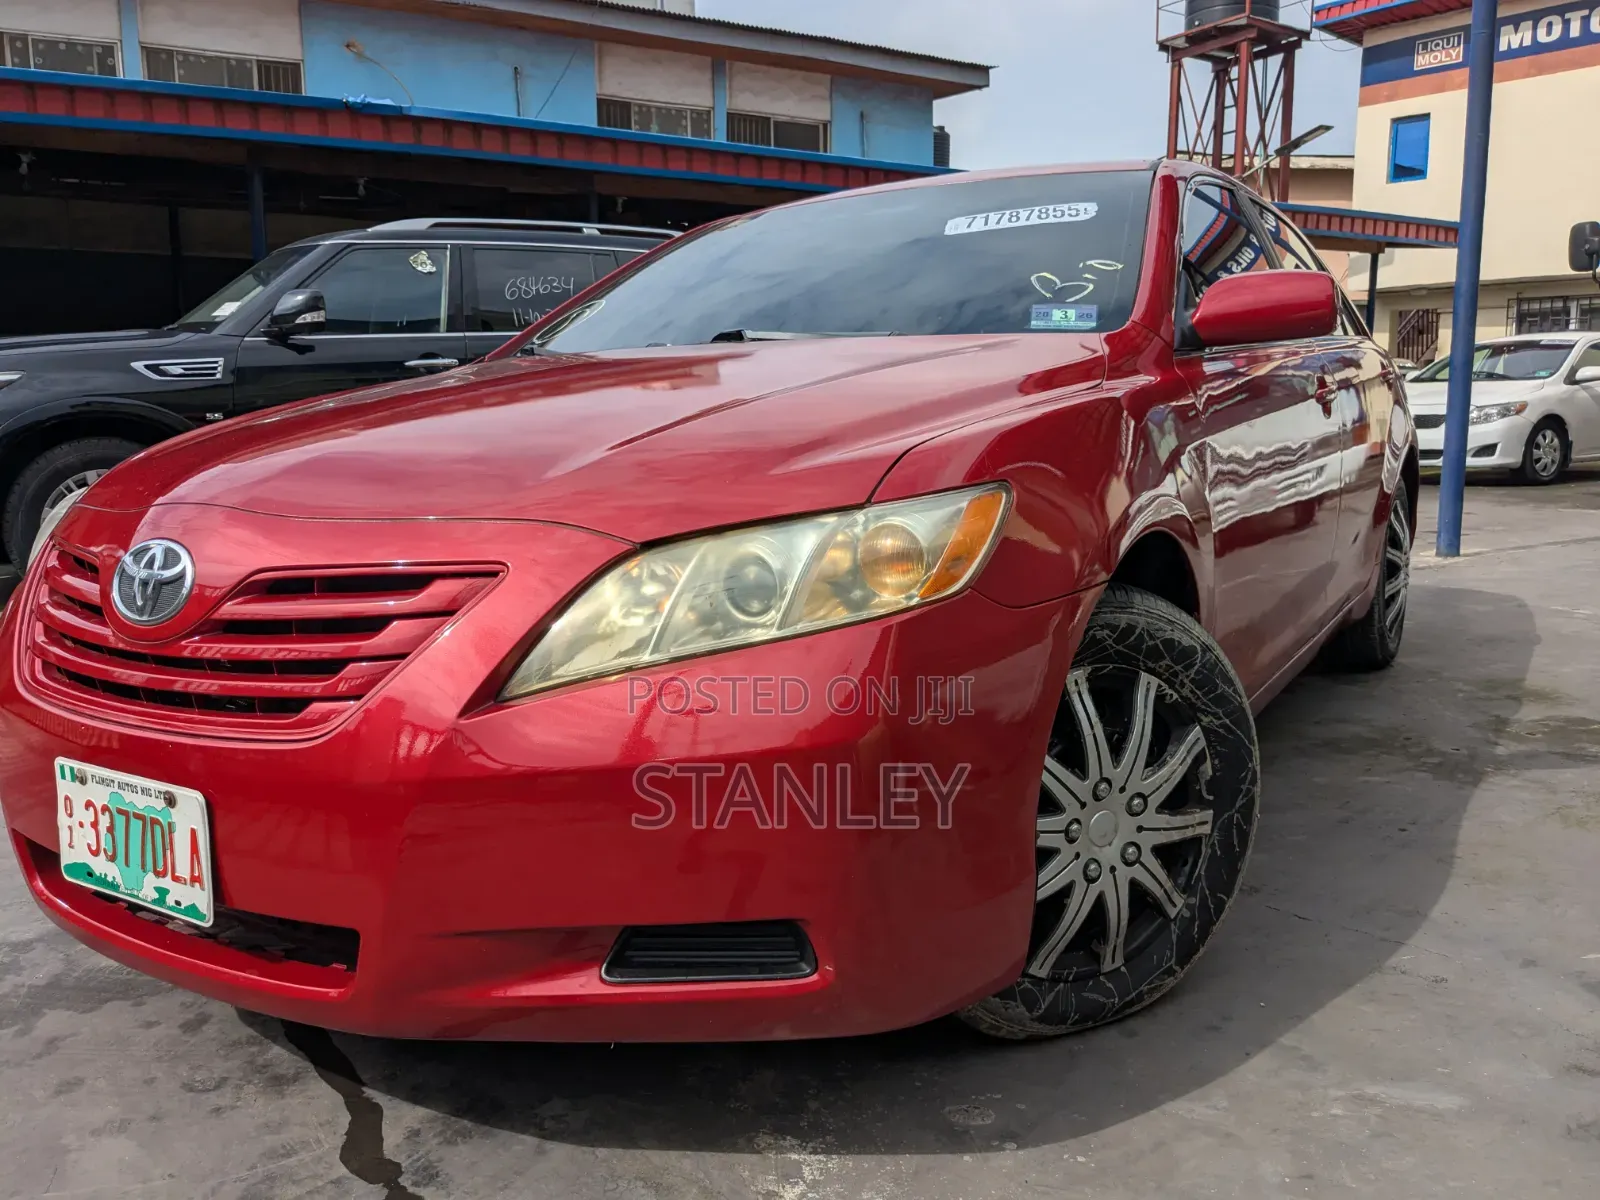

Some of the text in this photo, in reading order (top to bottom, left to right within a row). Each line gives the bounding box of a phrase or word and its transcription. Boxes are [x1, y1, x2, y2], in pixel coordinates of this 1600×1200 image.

[1418, 35, 1458, 54] LIQUI
[1417, 48, 1460, 67] MOLY
[964, 204, 1080, 229] 71787855
[1060, 309, 1069, 320] 3
[117, 780, 139, 794] AUTOS
[140, 786, 153, 798] NIG
